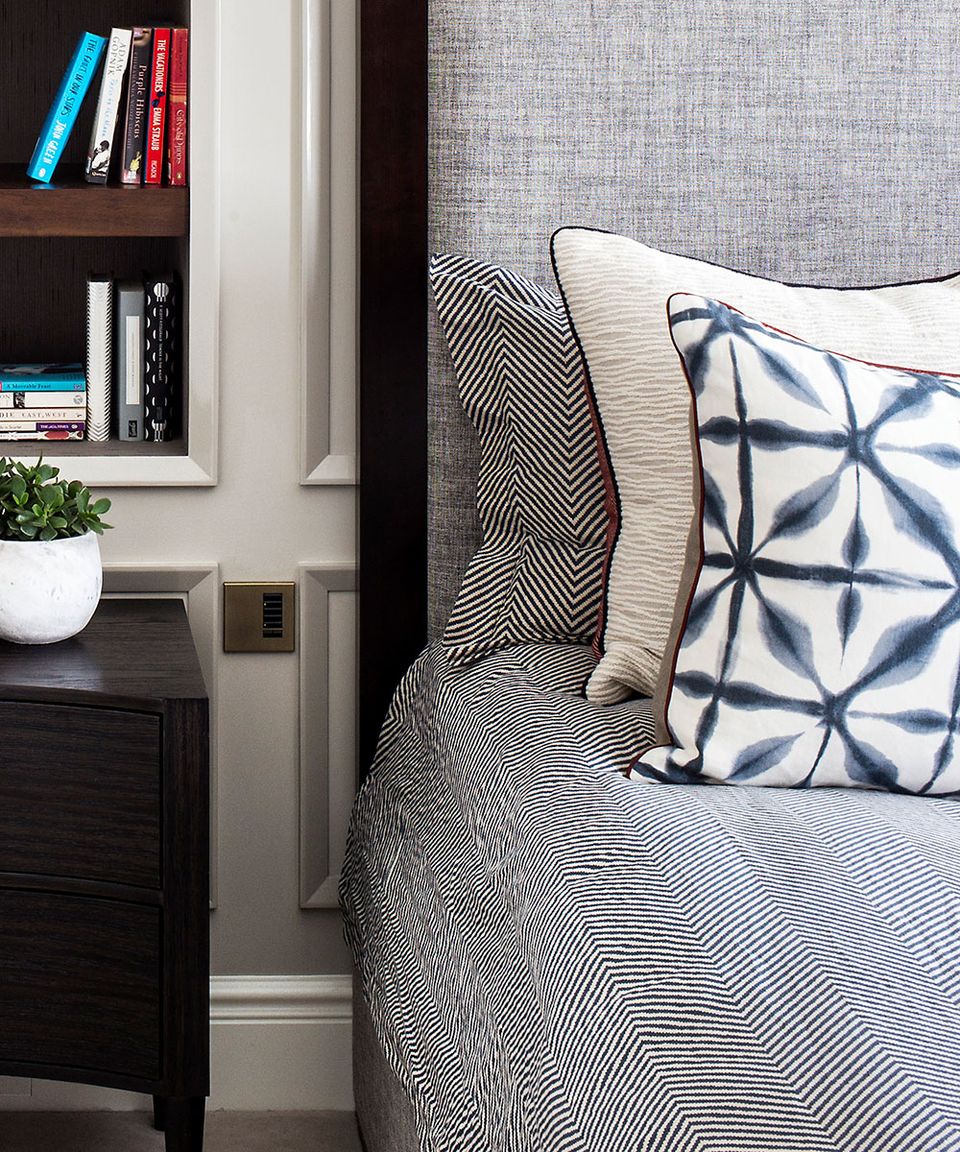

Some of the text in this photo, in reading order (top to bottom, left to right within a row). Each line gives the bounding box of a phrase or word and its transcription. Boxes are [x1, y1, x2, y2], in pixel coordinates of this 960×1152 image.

[86, 39, 97, 53] THE
[107, 36, 120, 76] GOPNIK
[116, 42, 126, 72] ADAM
[154, 40, 166, 93] THE VACATIONERS
[133, 64, 147, 139] Purple Hibiscus
[42, 120, 66, 165] JOHN GREEN
[151, 108, 162, 151] EMMA STRAUB
